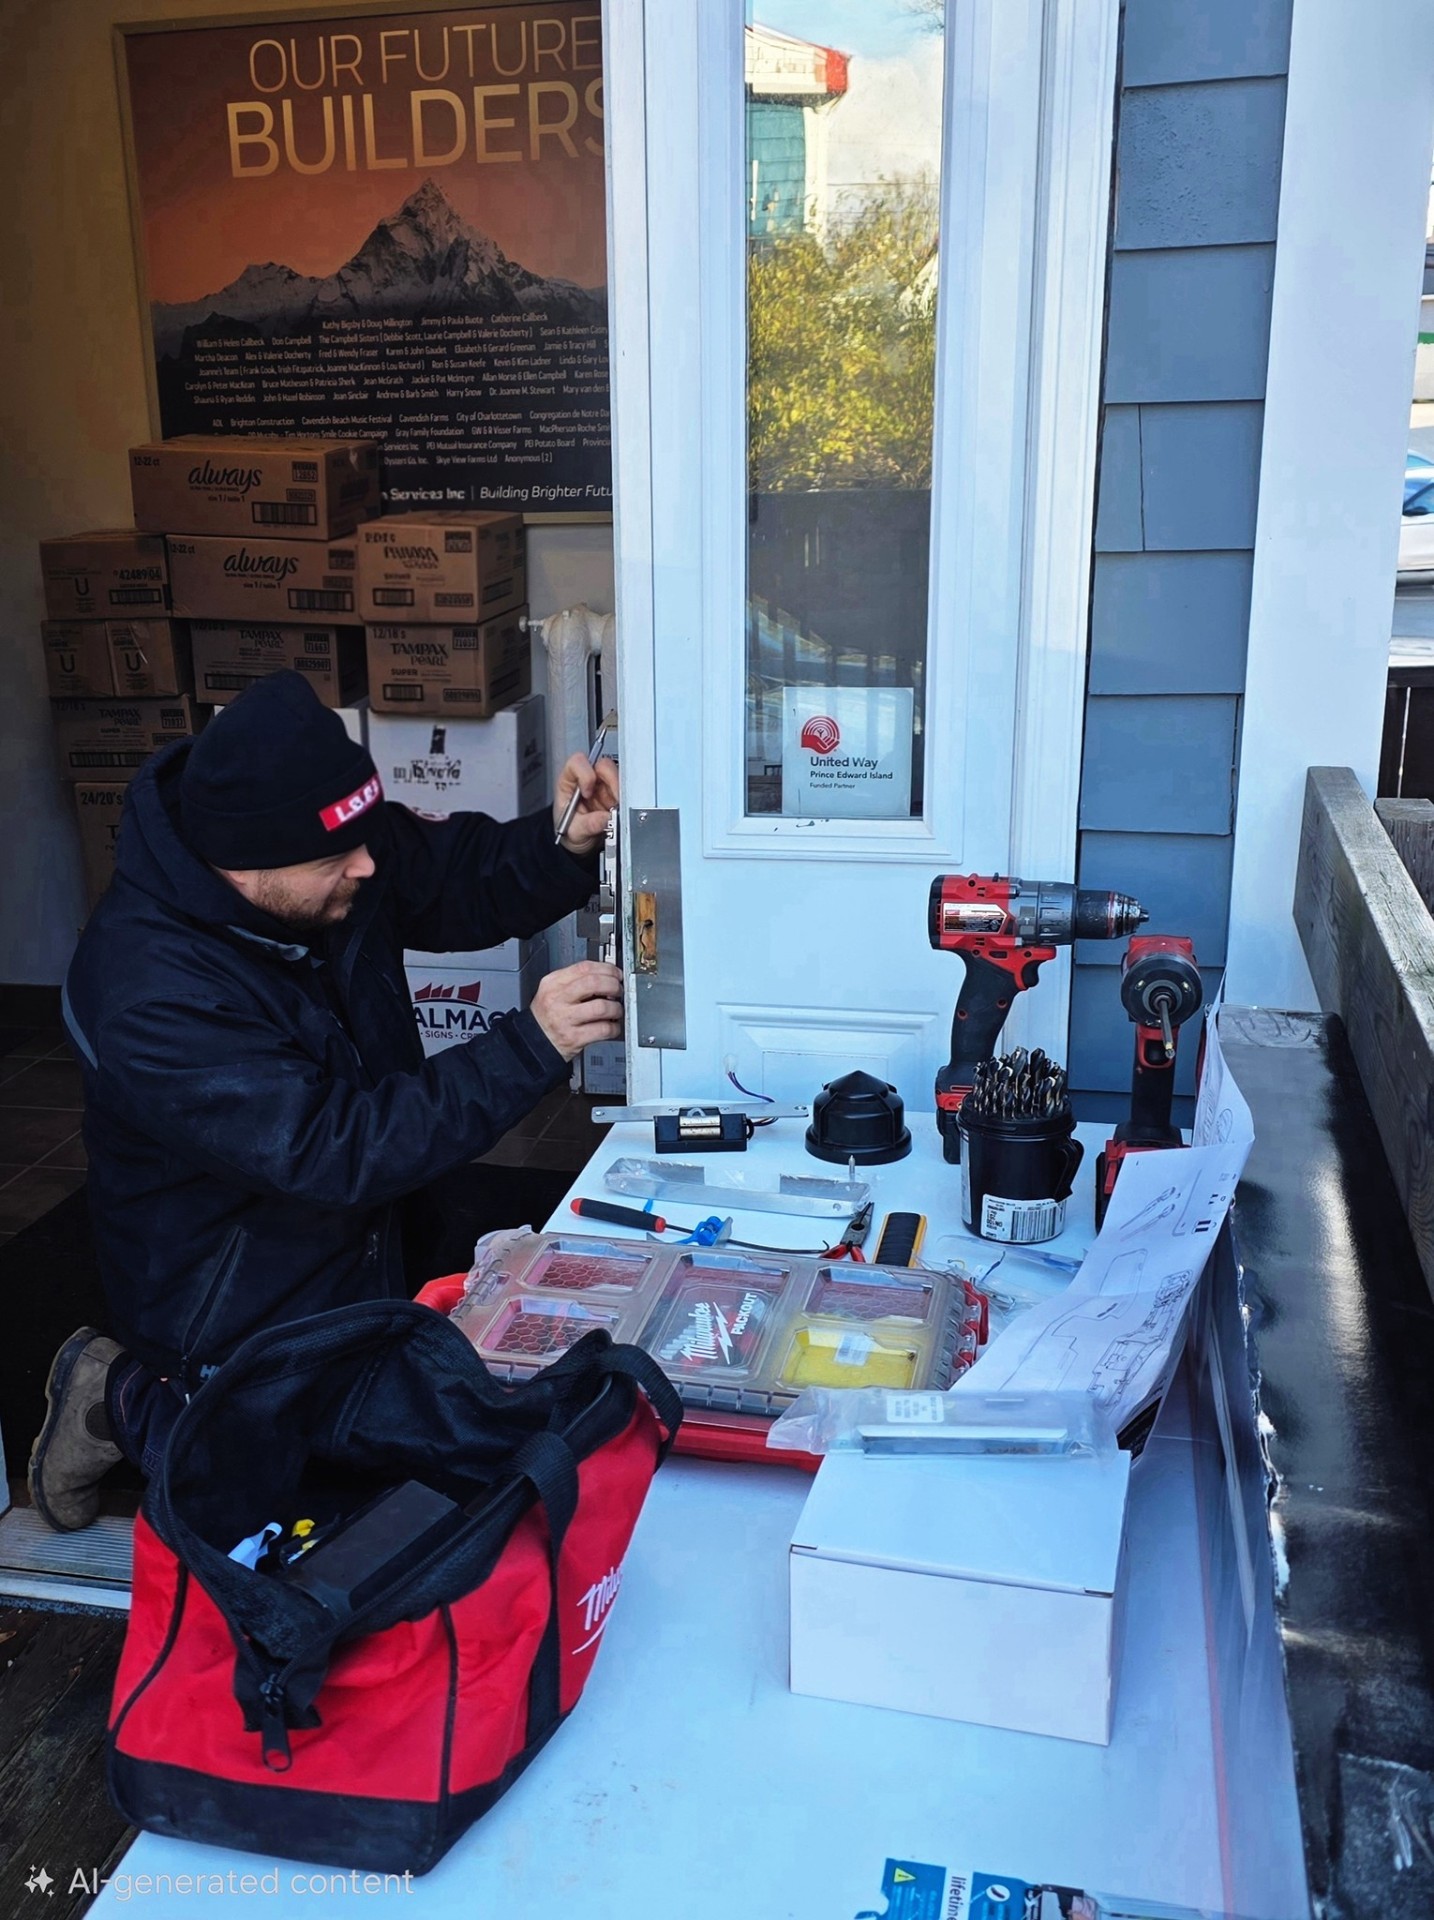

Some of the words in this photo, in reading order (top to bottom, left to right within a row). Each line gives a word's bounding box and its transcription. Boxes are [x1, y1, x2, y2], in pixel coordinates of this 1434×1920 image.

[249, 33, 363, 93] OUR
[380, 16, 601, 84] FUTURE
[188, 459, 263, 494] always
[390, 487, 443, 501] Services
[446, 487, 465, 499] Inc
[480, 486, 529, 501] Building
[531, 485, 583, 500] Brighter
[585, 484, 612, 497] Futu
[223, 547, 299, 581] always
[239, 630, 284, 643] TAMPAX
[390, 643, 448, 658] TAMPAX
[391, 668, 418, 676] SUPER
[810, 756, 850, 767] United
[853, 757, 879, 770] Way
[810, 770, 835, 779] Prince
[837, 771, 868, 779] Edward
[413, 1006, 505, 1031] ALMA
[425, 1030, 454, 1039] SIGNS
[730, 1292, 758, 1335] PACKOUT
